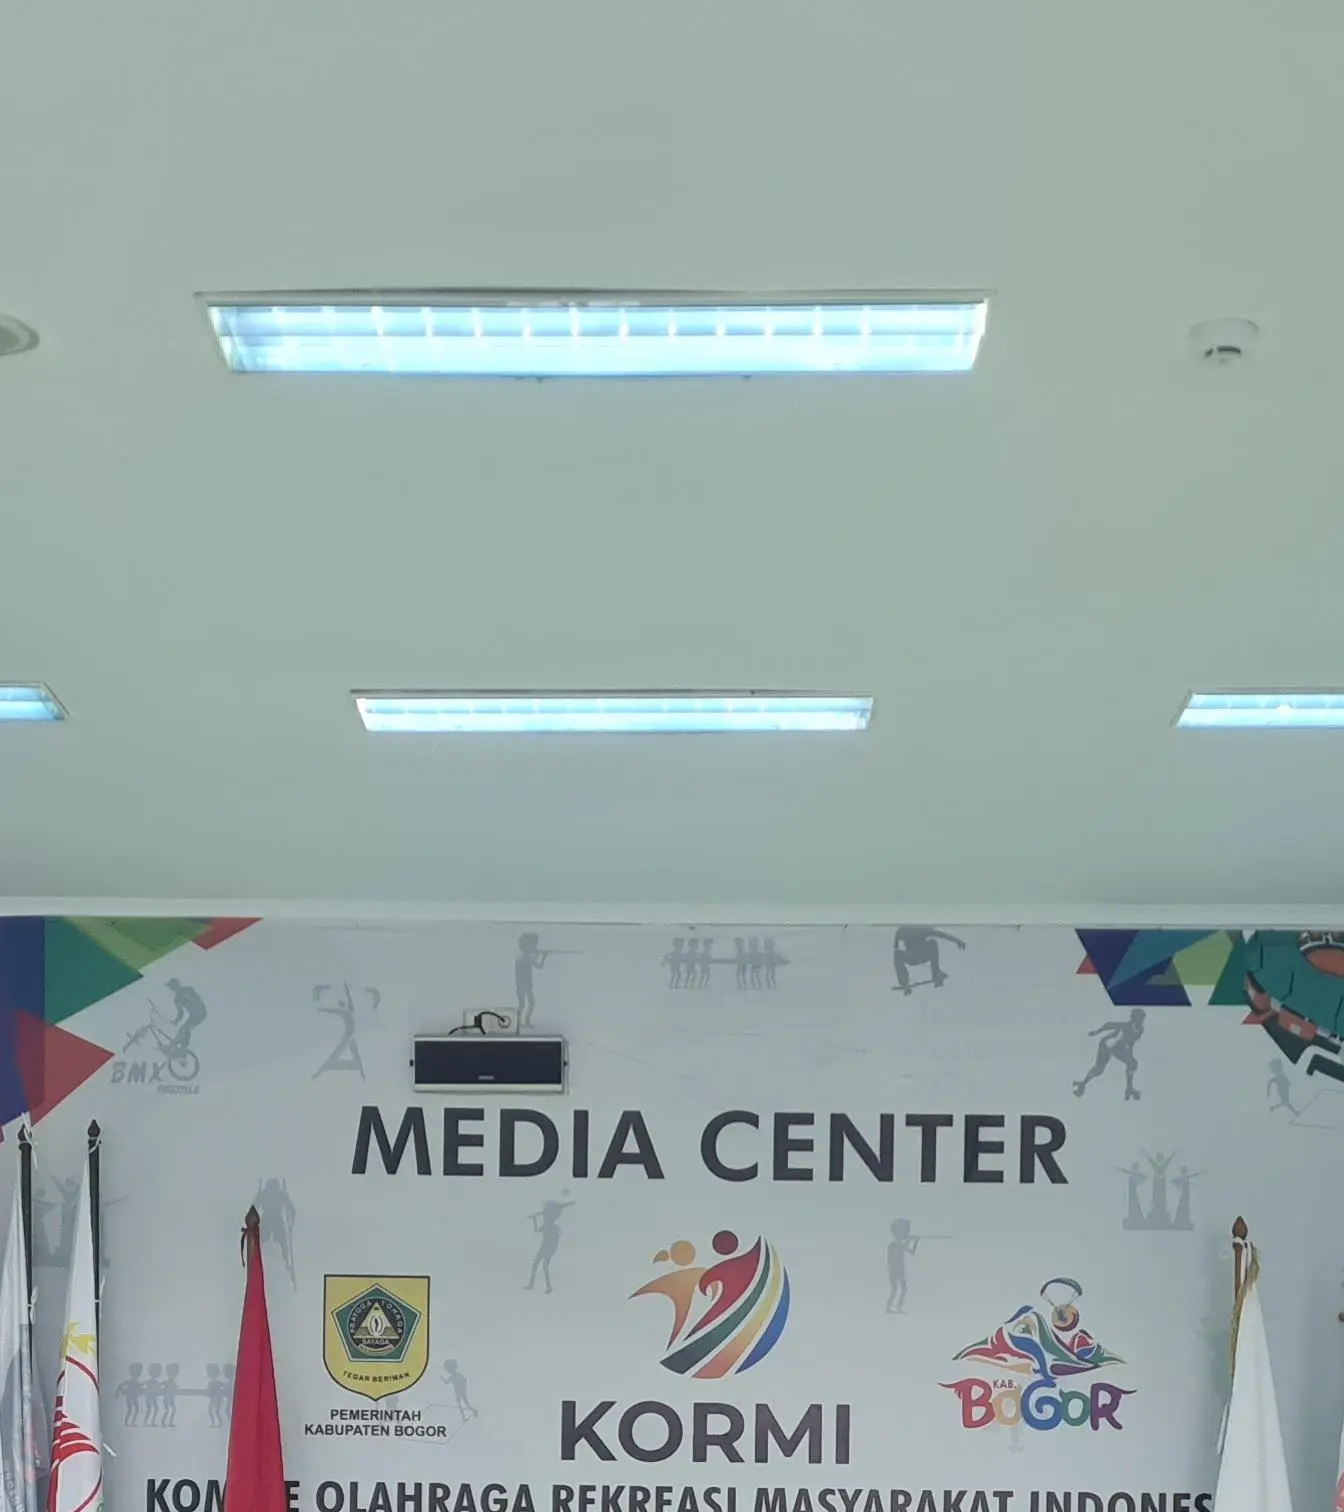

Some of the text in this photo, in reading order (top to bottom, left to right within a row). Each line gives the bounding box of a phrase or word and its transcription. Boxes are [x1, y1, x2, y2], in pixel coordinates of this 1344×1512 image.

[110, 1061, 167, 1085] BMX
[351, 1105, 1069, 1185] MEDIA CENTER
[330, 1409, 421, 1421] PEMERINTAH
[304, 1423, 447, 1438] KABUPATEN BOGOR
[560, 1399, 851, 1465] KORMI
